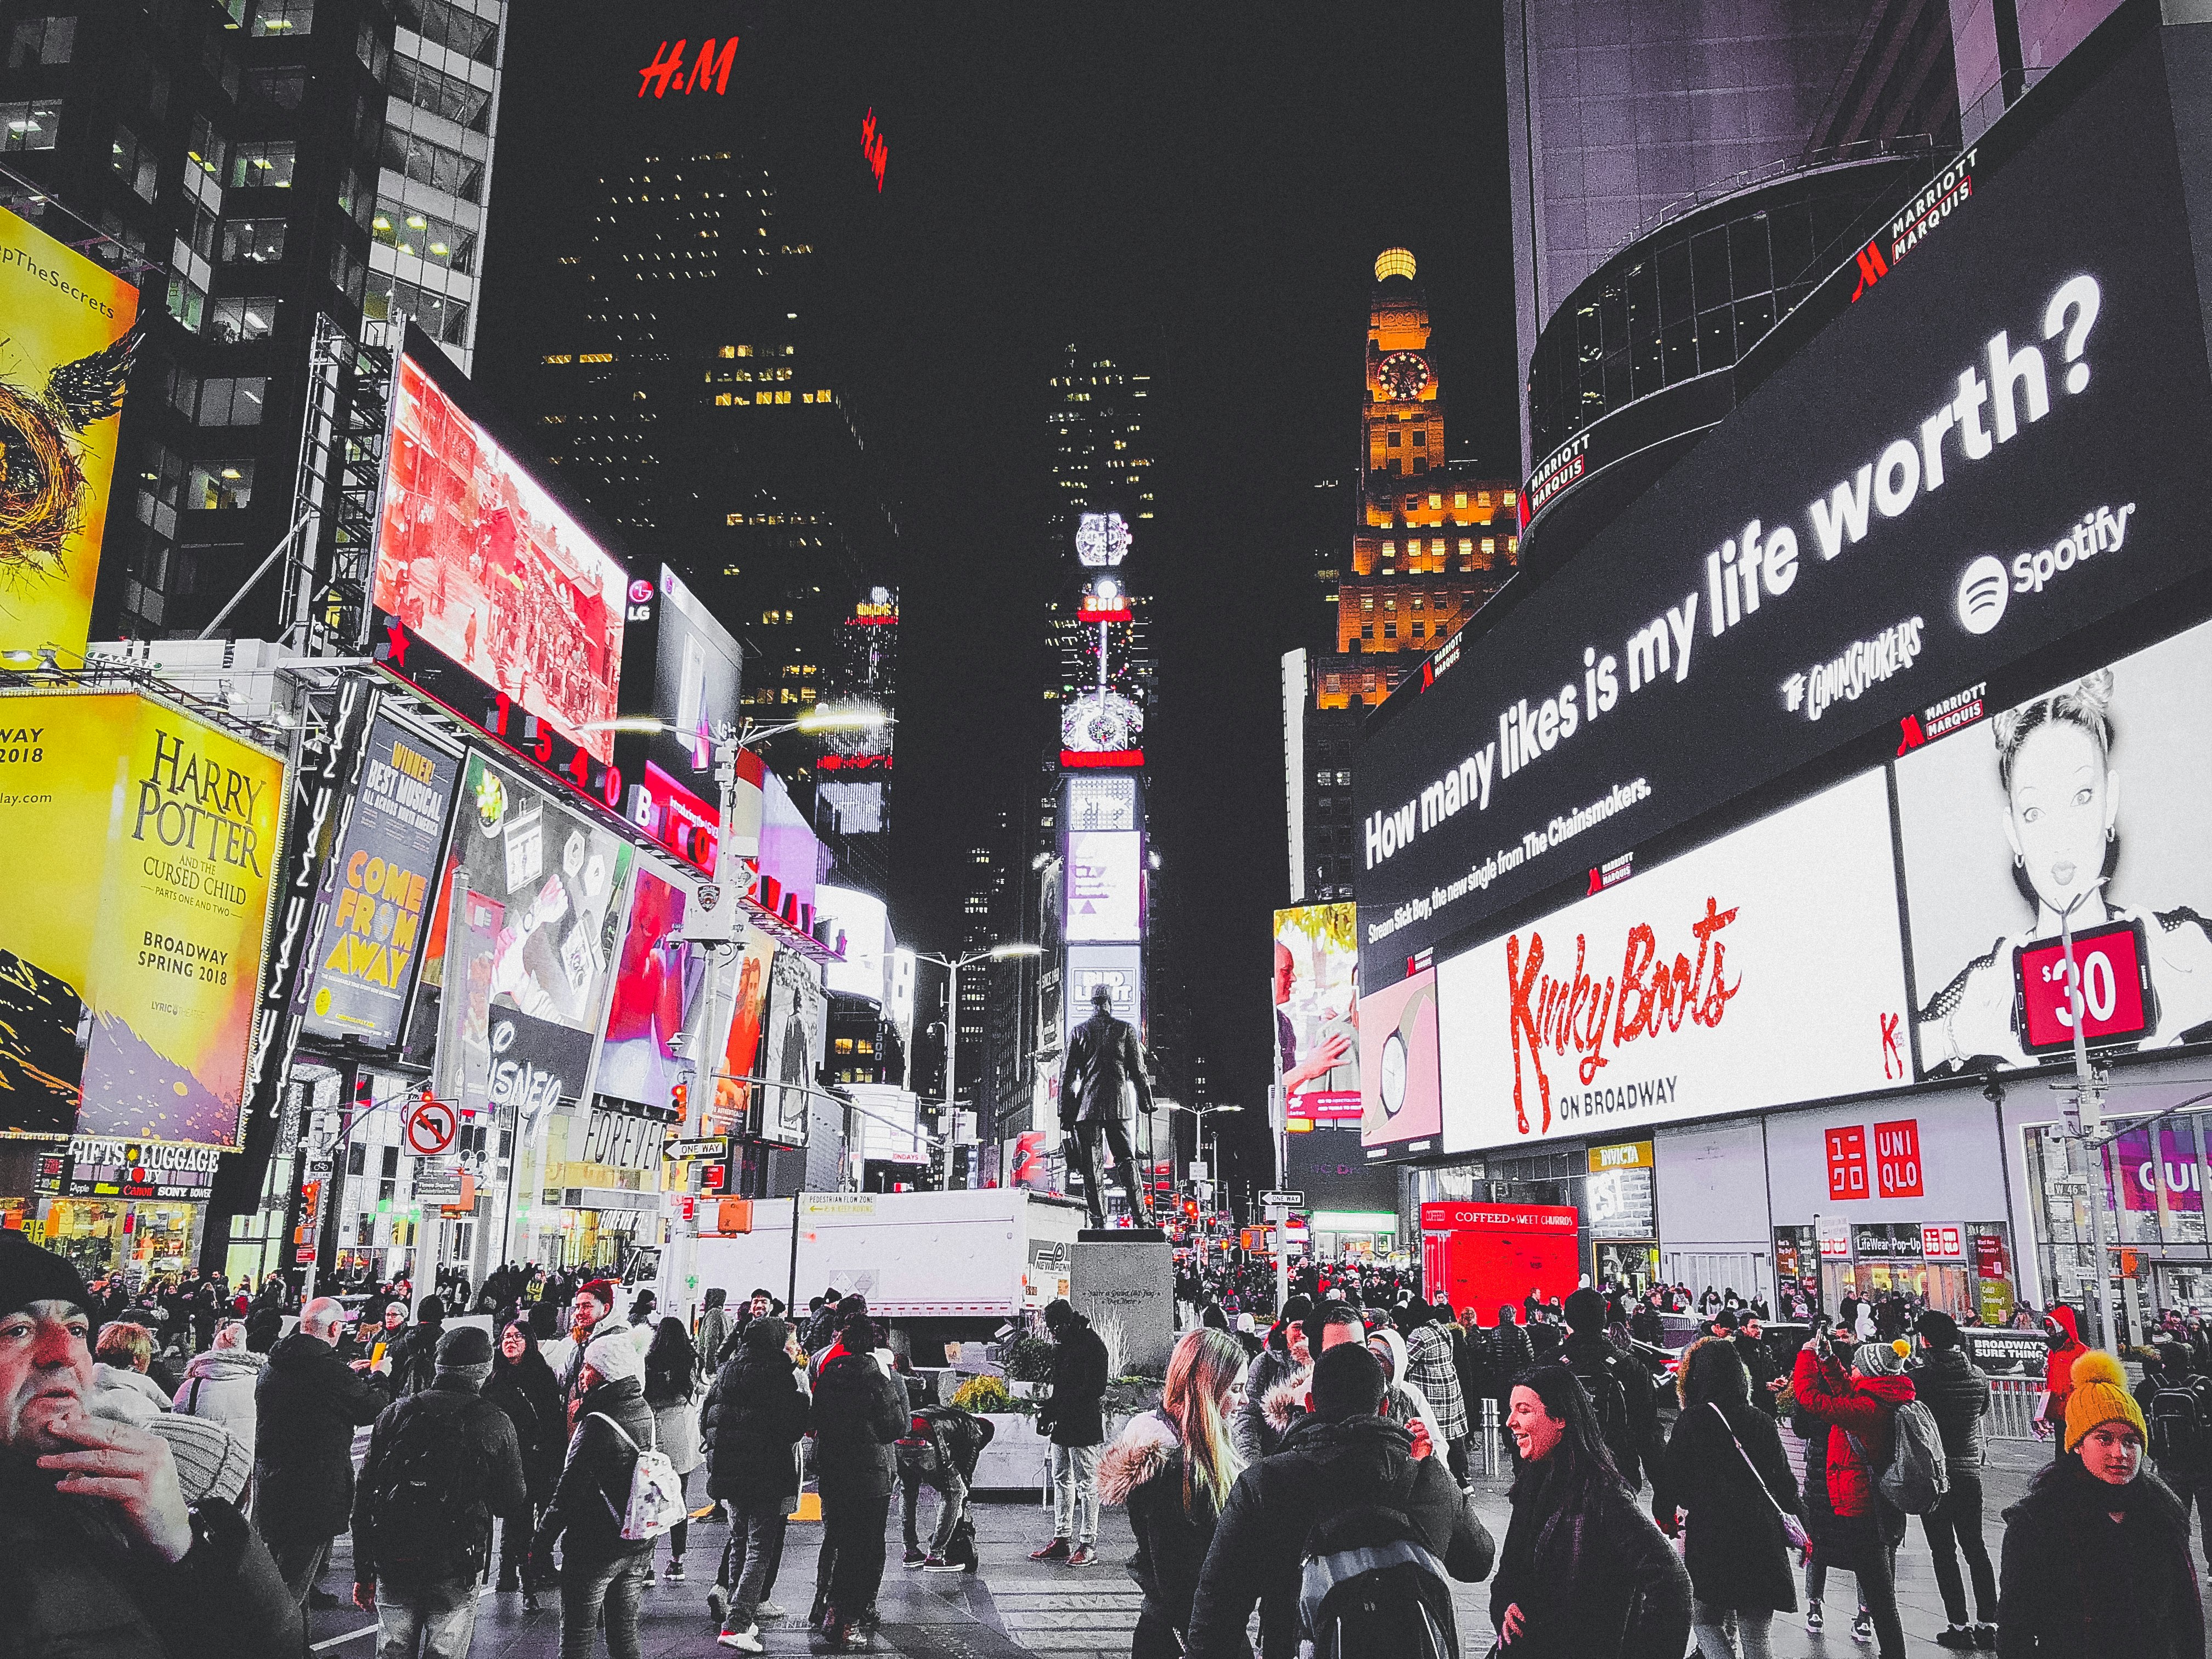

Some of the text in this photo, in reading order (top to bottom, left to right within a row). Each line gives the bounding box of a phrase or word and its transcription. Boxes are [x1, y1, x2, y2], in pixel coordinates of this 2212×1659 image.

[638, 36, 739, 99] H&M
[1893, 148, 1978, 239] MARRIOTT
[1895, 182, 1968, 259] MARQUIS
[0, 245, 114, 319] pTheSecrets
[1532, 433, 1589, 492] MARRIOTT
[1533, 459, 1582, 510] MARQUIS
[2013, 504, 2129, 592] Spotify
[1365, 275, 2100, 870] How many likes is my life worth?
[628, 606, 650, 620] LG
[1435, 632, 1462, 664] MARRIOTT
[1435, 648, 1460, 678] MARQUIS
[1925, 682, 1987, 721] MARRIOTT
[1927, 702, 1982, 737] MARQUIS
[149, 729, 267, 826] HARRY
[366, 758, 399, 798] BEST
[396, 774, 442, 822] MUSICAL
[362, 789, 374, 806] ALL
[374, 794, 398, 816] ACROSS
[132, 779, 263, 878] POTTER
[179, 854, 216, 876] AND THE
[1368, 777, 1652, 944] Stream Sick Boy, the new single from The Chainsmokers.
[1602, 852, 1634, 873] MARRIOTT
[1602, 866, 1630, 885] MARQUIS
[144, 856, 246, 905] CURSED CHILD
[347, 850, 426, 913] COME
[155, 886, 230, 917] PARTS ONE AND TWO
[335, 887, 421, 953] FROM
[143, 930, 228, 966] BROADWAY
[324, 931, 411, 991] AWAY
[138, 951, 228, 985] SPRING 2018
[1083, 971, 1124, 986] BUD
[2041, 950, 2116, 1027] $30
[151, 1001, 173, 1014] LYRIC
[1507, 895, 1742, 1135] Kinky Boots
[1560, 1075, 1678, 1121] ON BROADWAY
[68, 1139, 219, 1173] GIFTS LUGGAGE
[681, 1143, 720, 1154] ONE WAY
[1600, 1146, 1639, 1166] INVICTA
[1880, 1130, 1913, 1158] UNI
[123, 1184, 155, 1197] Canon
[157, 1186, 187, 1197] SONY
[143, 1169, 161, 1183] NY
[1882, 1164, 1917, 1193] QLO
[2055, 1183, 2078, 1194] W 46
[601, 1210, 635, 1231] FOREVER
[1455, 1212, 1510, 1224] COFFEED
[1516, 1215, 1539, 1225] SWEET
[1541, 1215, 1573, 1226] CHURROS
[1857, 1236, 1921, 1255] LifeWear Pop-Up
[1035, 1261, 1050, 1271] NEW
[1974, 1339, 2048, 1351] BROADWAY'S
[1975, 1348, 2044, 1359] SURE THING
